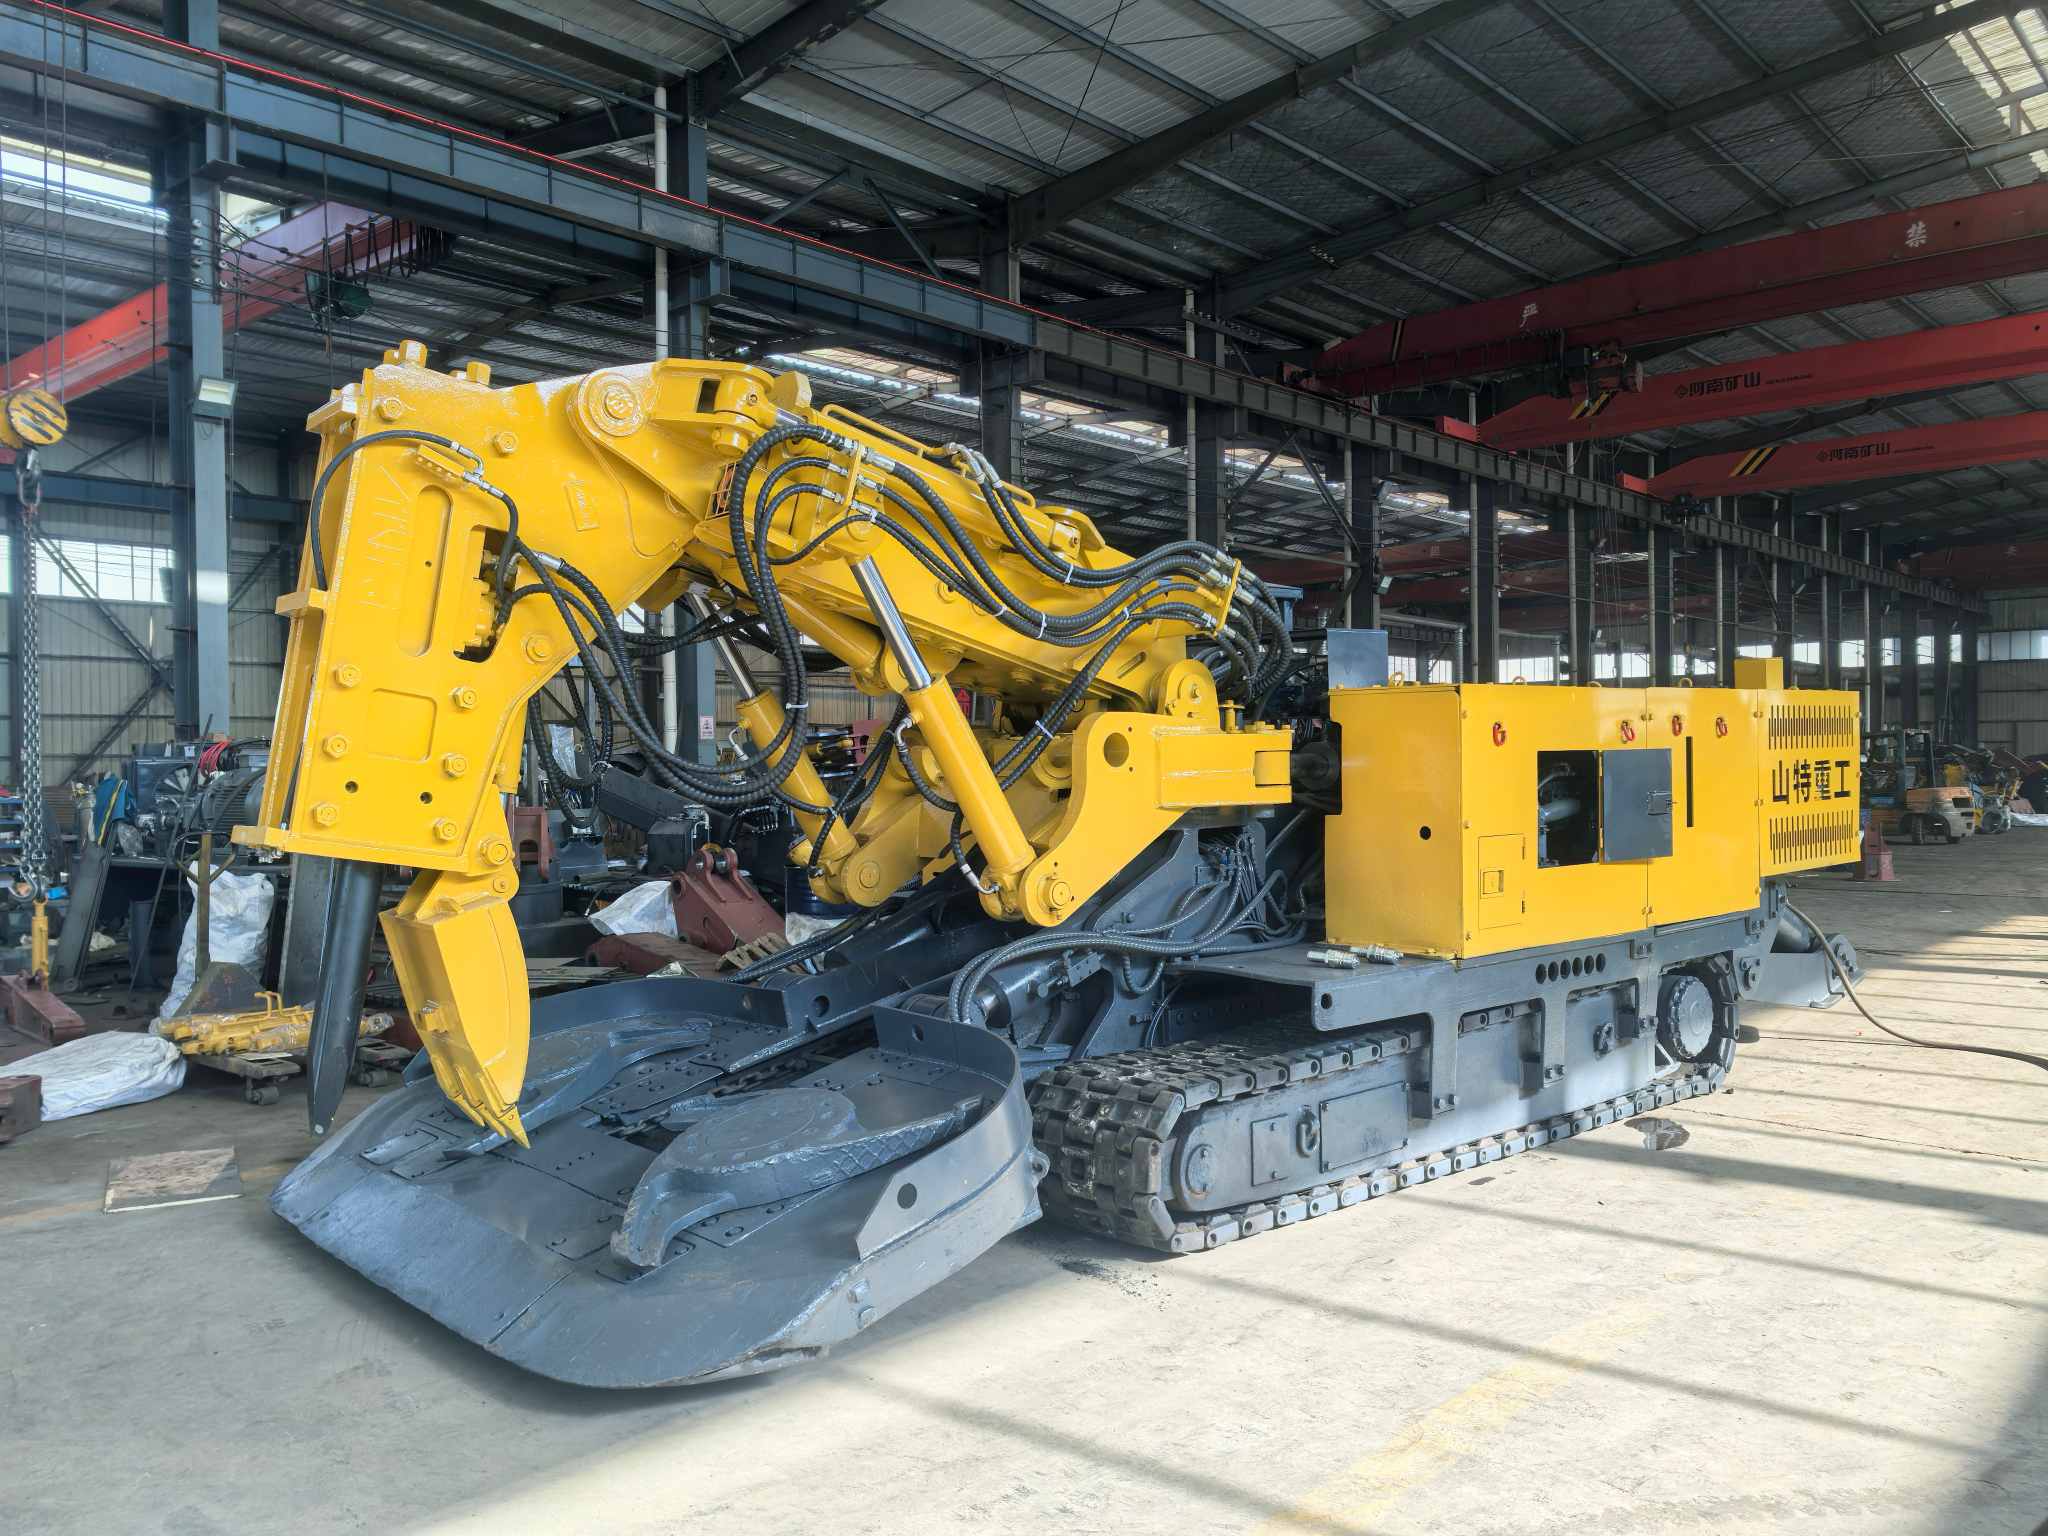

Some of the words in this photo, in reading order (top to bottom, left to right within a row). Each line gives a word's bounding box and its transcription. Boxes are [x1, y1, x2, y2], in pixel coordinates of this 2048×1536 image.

[1904, 221, 1928, 248] 禁
[1771, 758, 1851, 804] 山特重工
